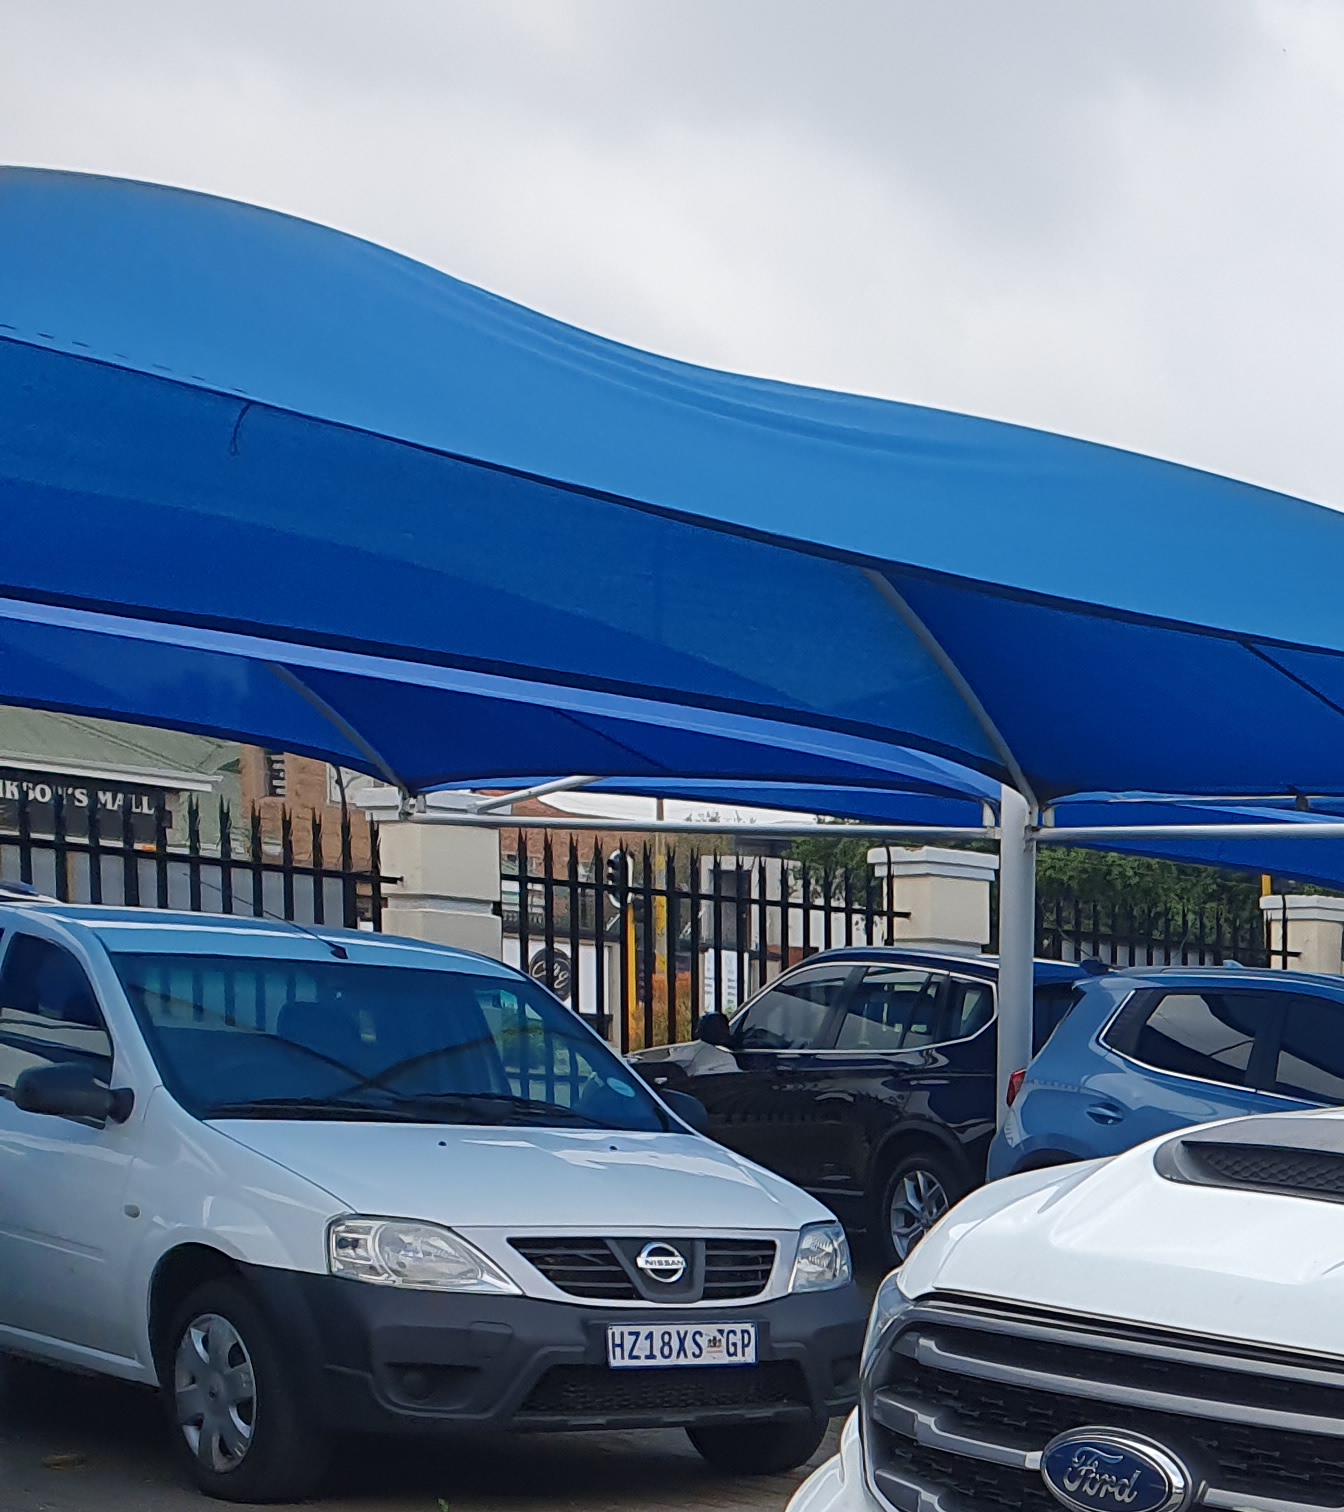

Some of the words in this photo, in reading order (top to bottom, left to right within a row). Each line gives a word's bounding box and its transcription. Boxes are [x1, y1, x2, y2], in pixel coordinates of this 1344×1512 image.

[645, 1259, 684, 1267] NISSAN
[611, 1329, 704, 1361] HZ18XS
[725, 1328, 752, 1358] GP
[1063, 1446, 1141, 1503] Ford
